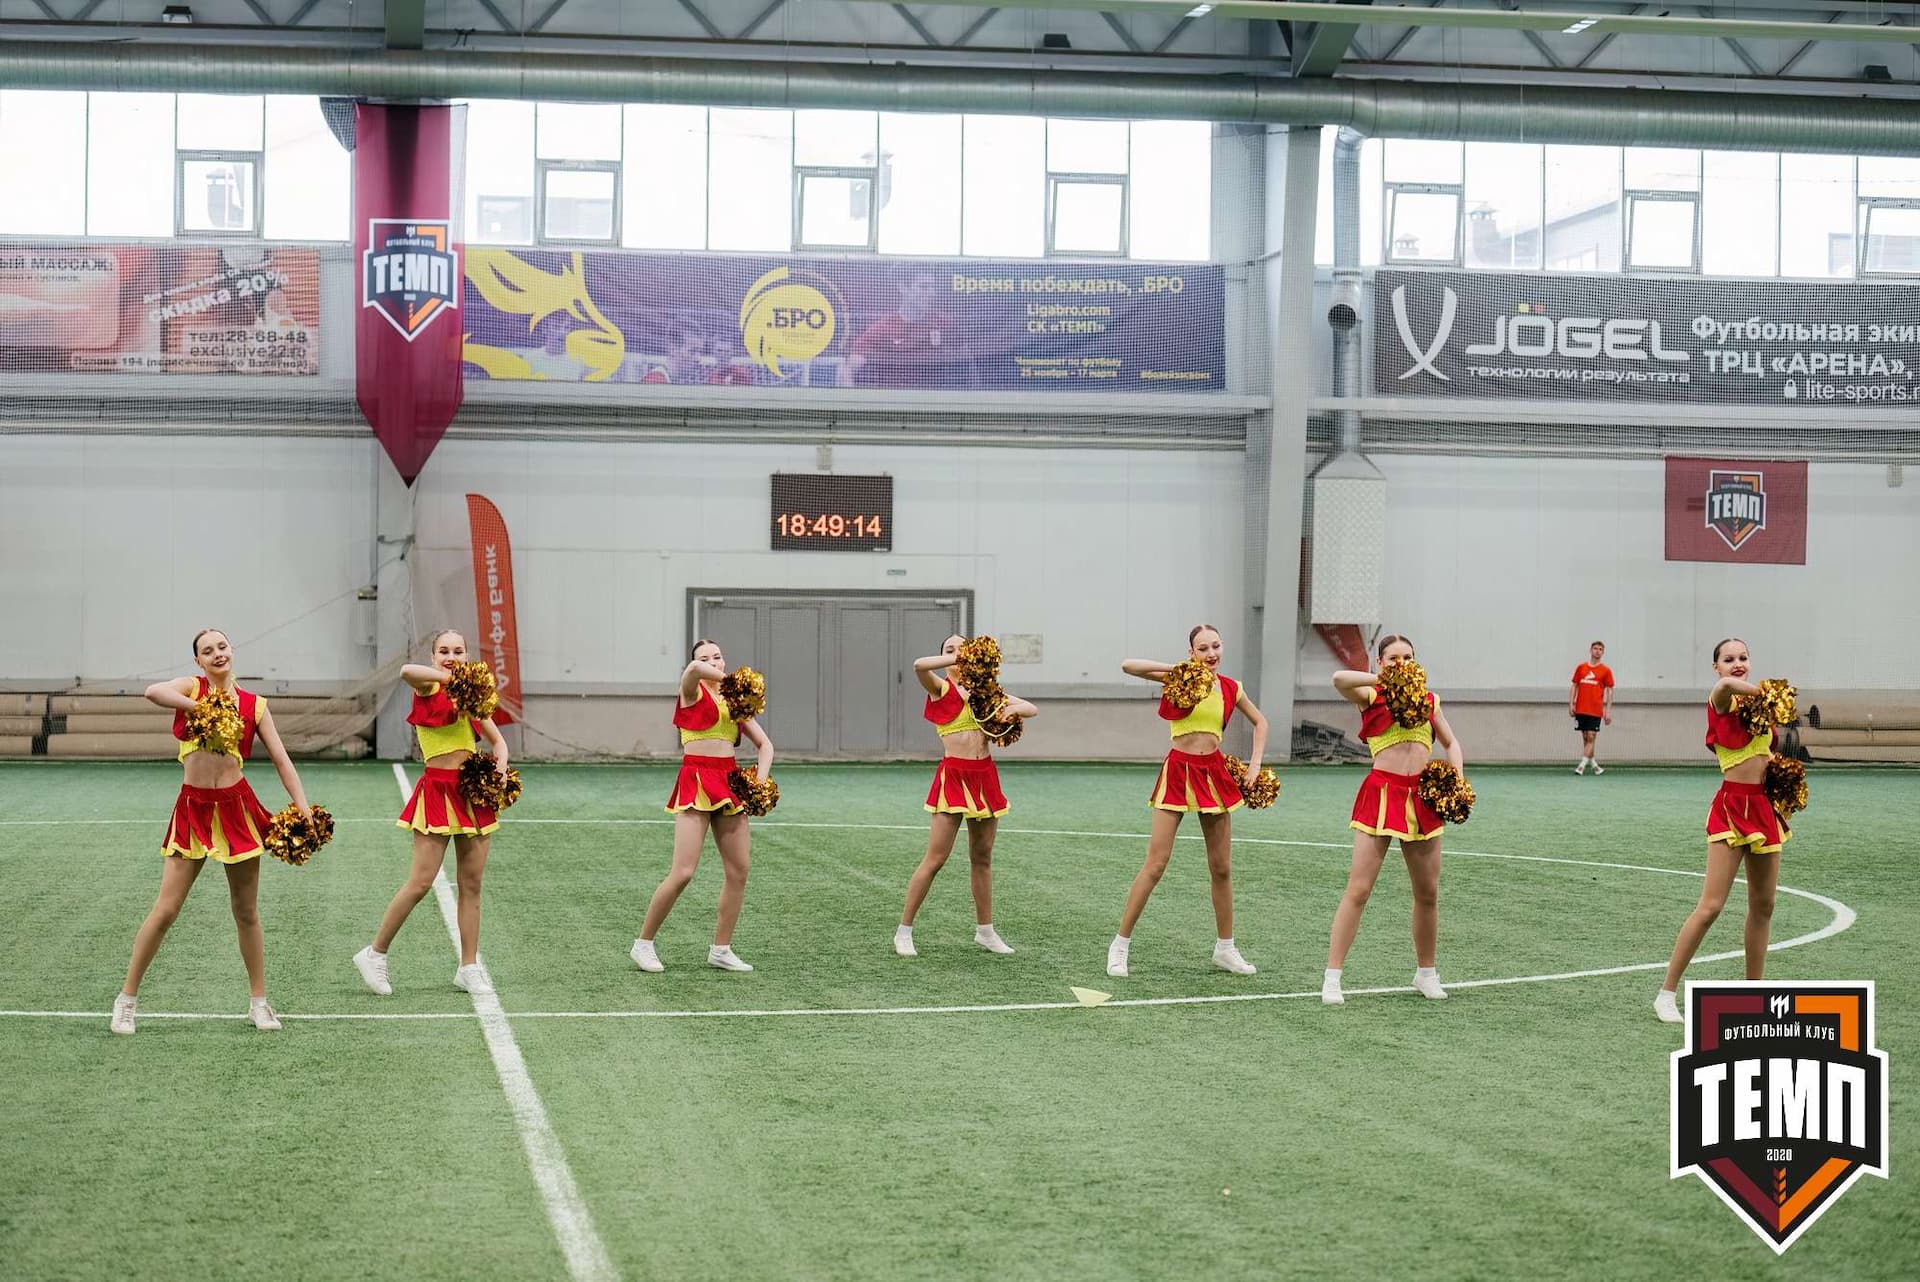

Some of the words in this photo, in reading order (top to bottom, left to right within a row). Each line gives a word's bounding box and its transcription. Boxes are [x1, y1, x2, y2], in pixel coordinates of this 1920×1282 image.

[236, 270, 288, 298] 20%
[373, 253, 448, 295] ТЕМП
[952, 274, 1014, 294] Время
[766, 308, 827, 330] .БРО
[1692, 315, 1859, 344] Футбольная
[1467, 366, 1578, 380] технологии
[1582, 369, 1690, 384] результата
[1704, 351, 1764, 378] ТРЦ
[1771, 353, 1912, 379] «АРЕНА»,
[1712, 493, 1761, 521] ТЕМП
[777, 513, 882, 538] 18:49:14
